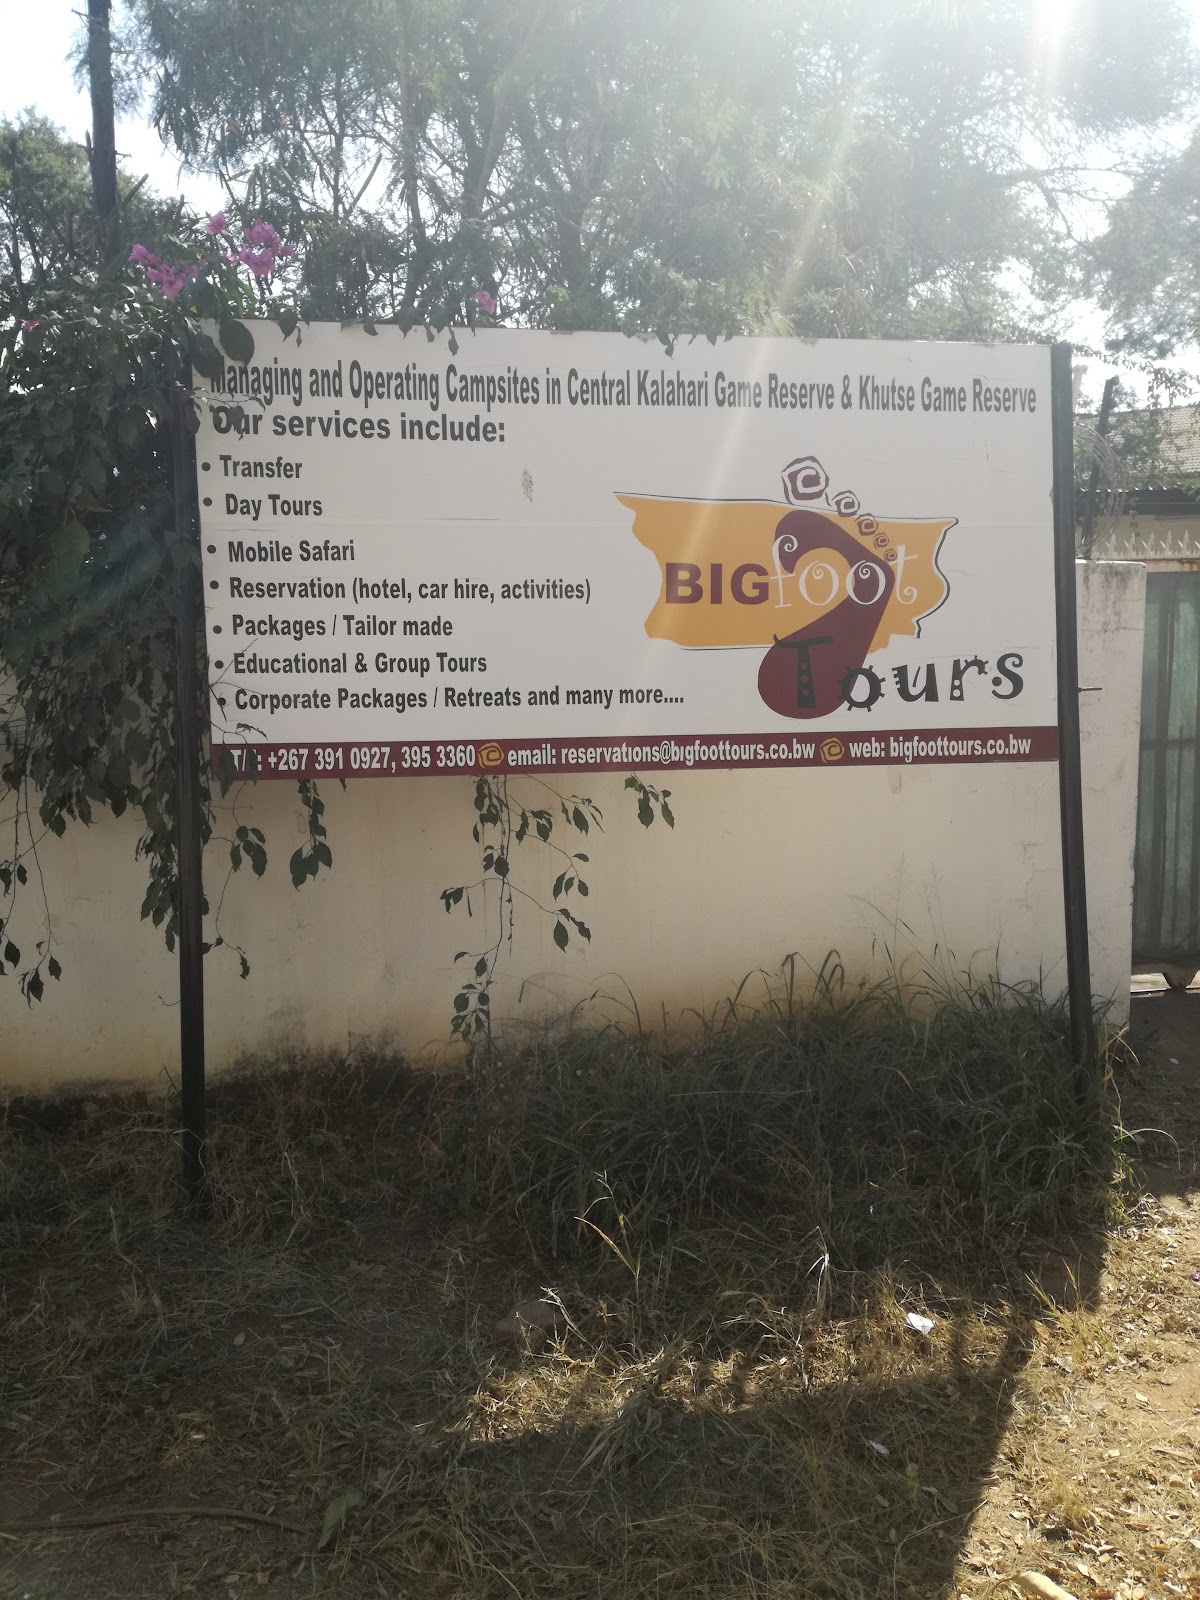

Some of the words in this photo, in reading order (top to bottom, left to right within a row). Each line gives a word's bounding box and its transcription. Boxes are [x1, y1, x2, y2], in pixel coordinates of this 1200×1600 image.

[309, 360, 342, 398] and
[349, 360, 439, 411] Operating
[446, 365, 540, 412] Campsites
[546, 367, 561, 405] in
[567, 368, 632, 406] Central
[637, 370, 708, 407] Kalahari
[714, 371, 762, 408] Game
[768, 373, 835, 409] Reserve
[841, 374, 853, 410] &
[859, 374, 915, 411] Khutse
[921, 377, 966, 412] Game
[973, 378, 1037, 413] Reserve
[272, 411, 391, 439] services
[400, 412, 505, 442] include:
[219, 455, 303, 479] Transfer
[225, 494, 261, 520] Day
[268, 494, 323, 516] Tours
[228, 540, 293, 562] Mobile
[299, 540, 355, 561] Safari
[229, 576, 346, 598] Reservation
[352, 577, 412, 604] (hotel,
[418, 580, 449, 600] car
[453, 578, 495, 603] hire,
[500, 578, 591, 604] activities)
[232, 614, 326, 641] Packages
[332, 615, 337, 636] /
[342, 615, 397, 636] Tailor
[403, 615, 453, 636] made
[233, 653, 347, 674] Educational
[354, 653, 368, 673] &
[374, 653, 431, 677] Group
[436, 653, 487, 673] Tours
[773, 632, 1024, 712] Tours
[234, 689, 331, 715] Corporate
[337, 687, 428, 712] Packages
[433, 688, 438, 709] /
[444, 687, 521, 708] Retreats
[527, 686, 559, 707] and
[565, 688, 613, 710] many
[619, 687, 684, 705] more....
[267, 749, 308, 771] +267
[314, 748, 344, 770] 391
[350, 746, 396, 773] 0927,
[401, 746, 432, 768] 395
[436, 744, 476, 768] 3360
[507, 744, 556, 766] email:
[561, 738, 815, 766] reservations@bigfoottours.co.bw
[849, 740, 885, 758] web:
[889, 734, 1031, 763] bigfoottours.co.bw
